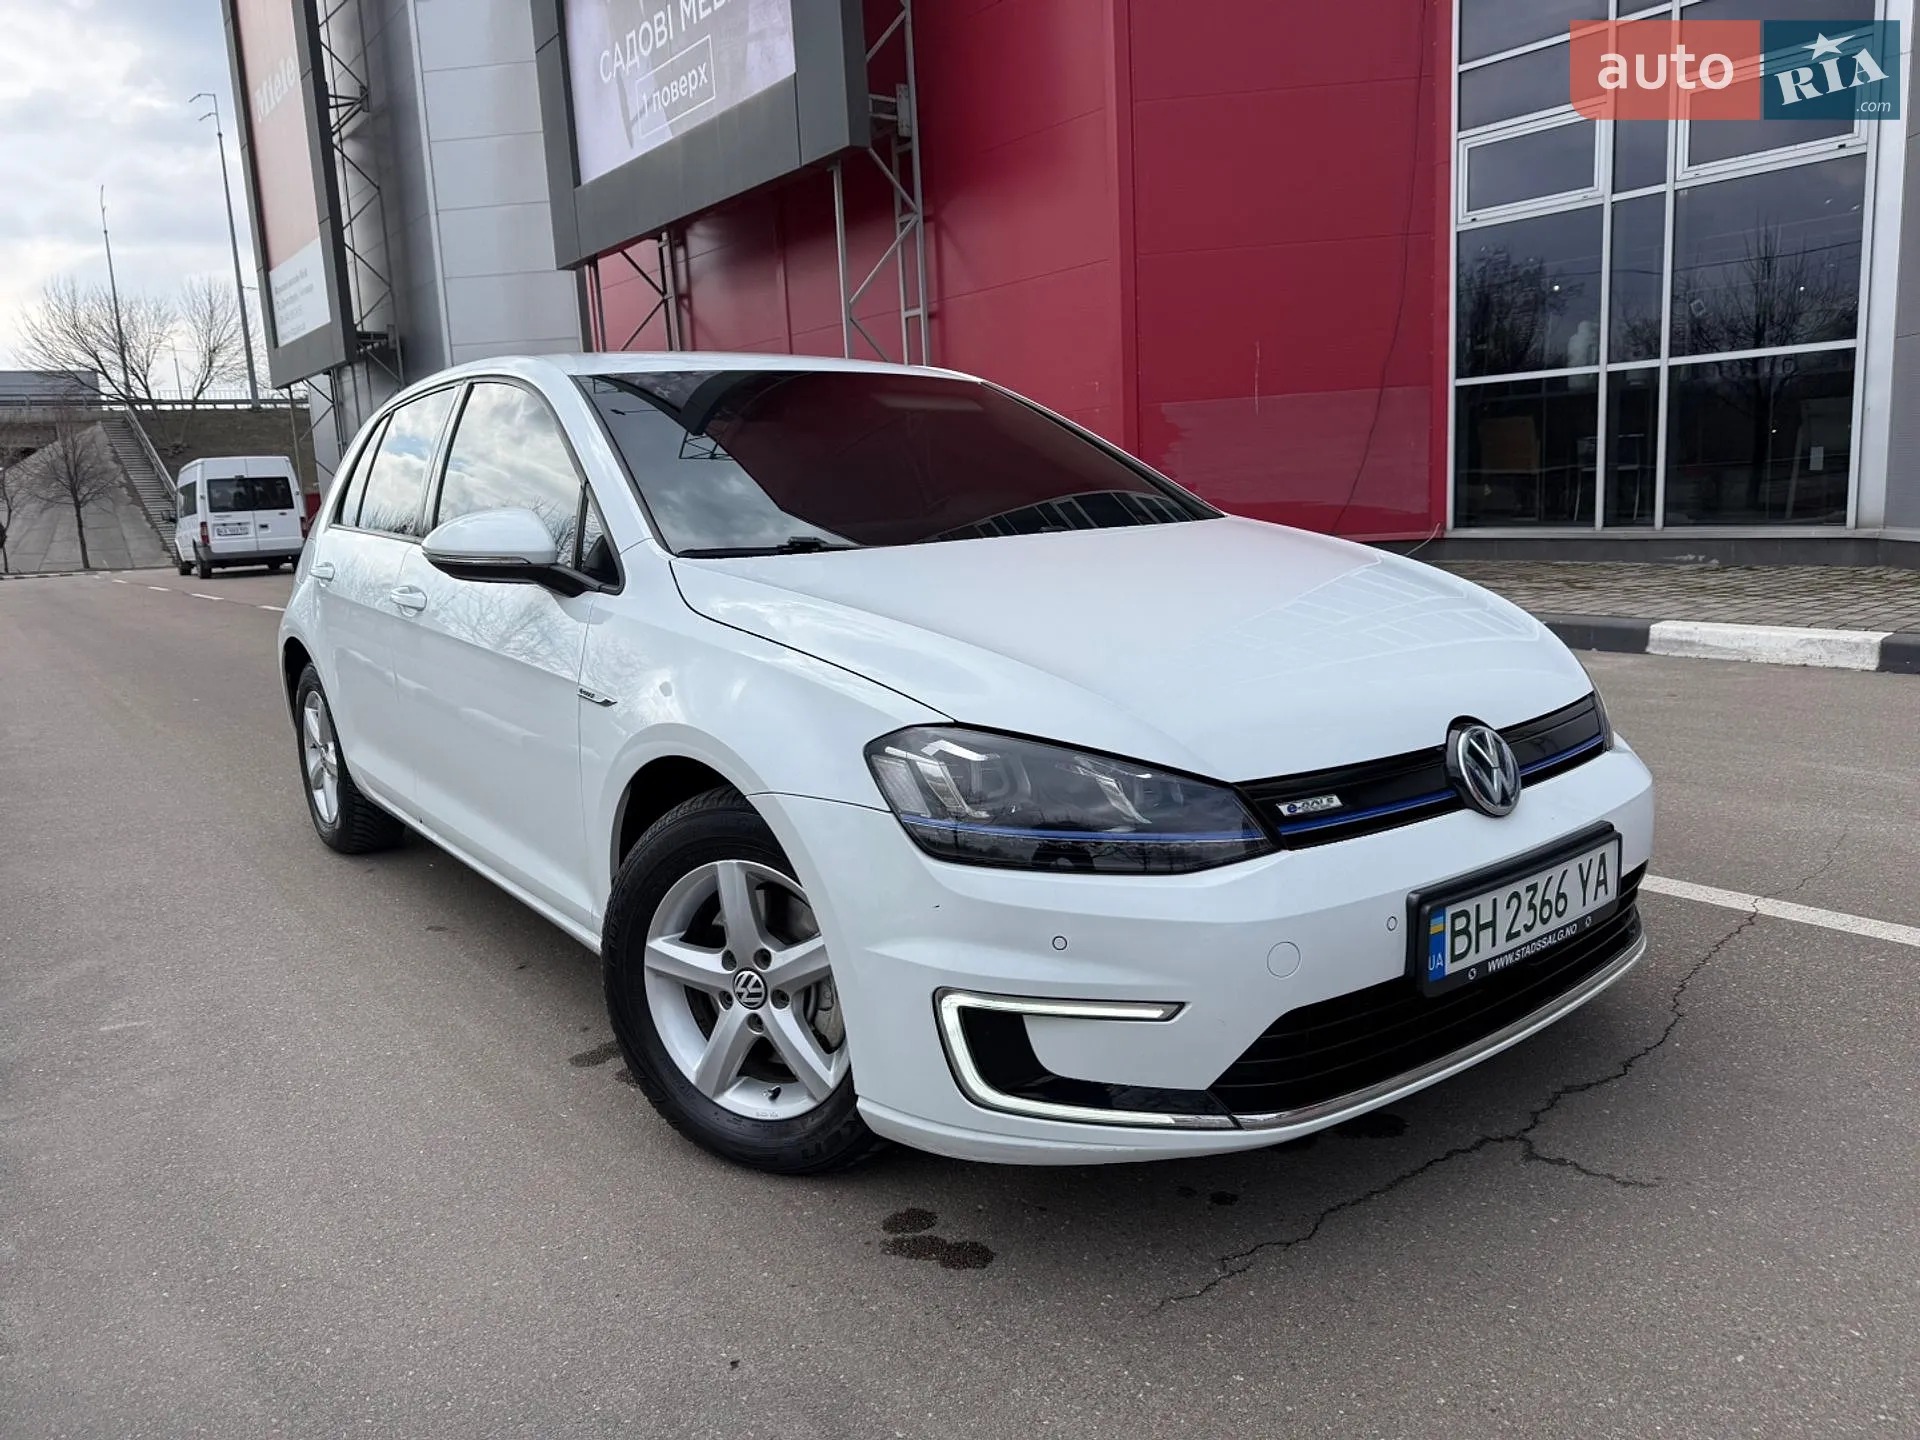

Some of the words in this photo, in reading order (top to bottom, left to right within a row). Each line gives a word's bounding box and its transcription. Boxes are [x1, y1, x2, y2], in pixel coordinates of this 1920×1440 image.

[600, 4, 674, 84] САДОВІ
[652, 62, 709, 113] поверх
[1450, 897, 1498, 964] BH
[1505, 869, 1569, 943] 2366
[1578, 852, 1609, 908] YA
[1428, 952, 1444, 971] UA
